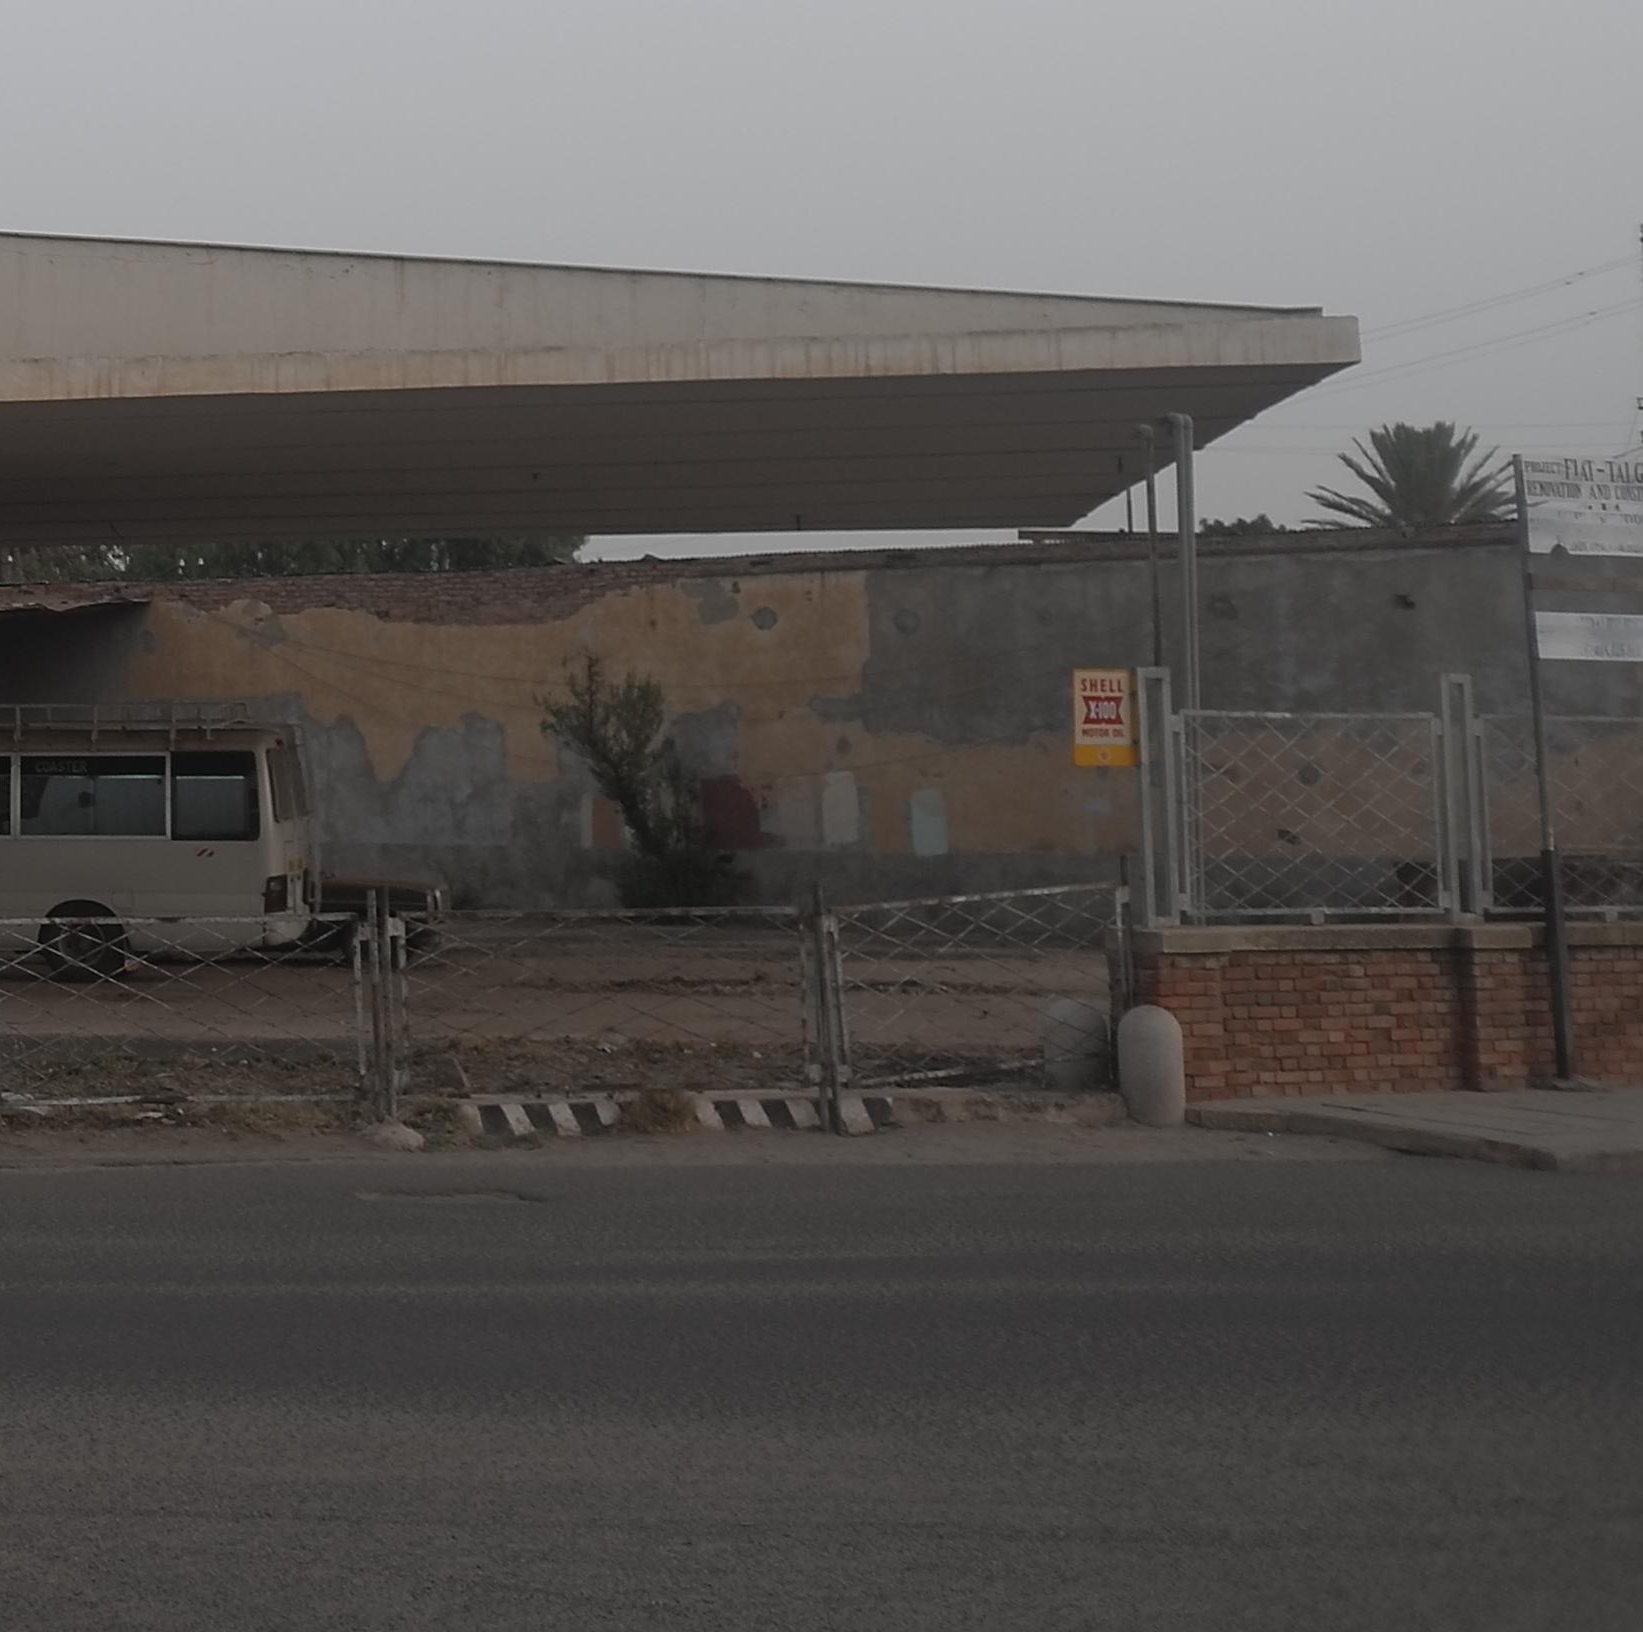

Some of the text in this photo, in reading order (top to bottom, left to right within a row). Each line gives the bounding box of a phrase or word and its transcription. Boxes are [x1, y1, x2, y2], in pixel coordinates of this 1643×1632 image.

[1587, 483, 1611, 500] AND
[1081, 678, 1123, 693] SHELL
[1082, 728, 1109, 738] MOTOR
[35, 761, 88, 773] COASTER
